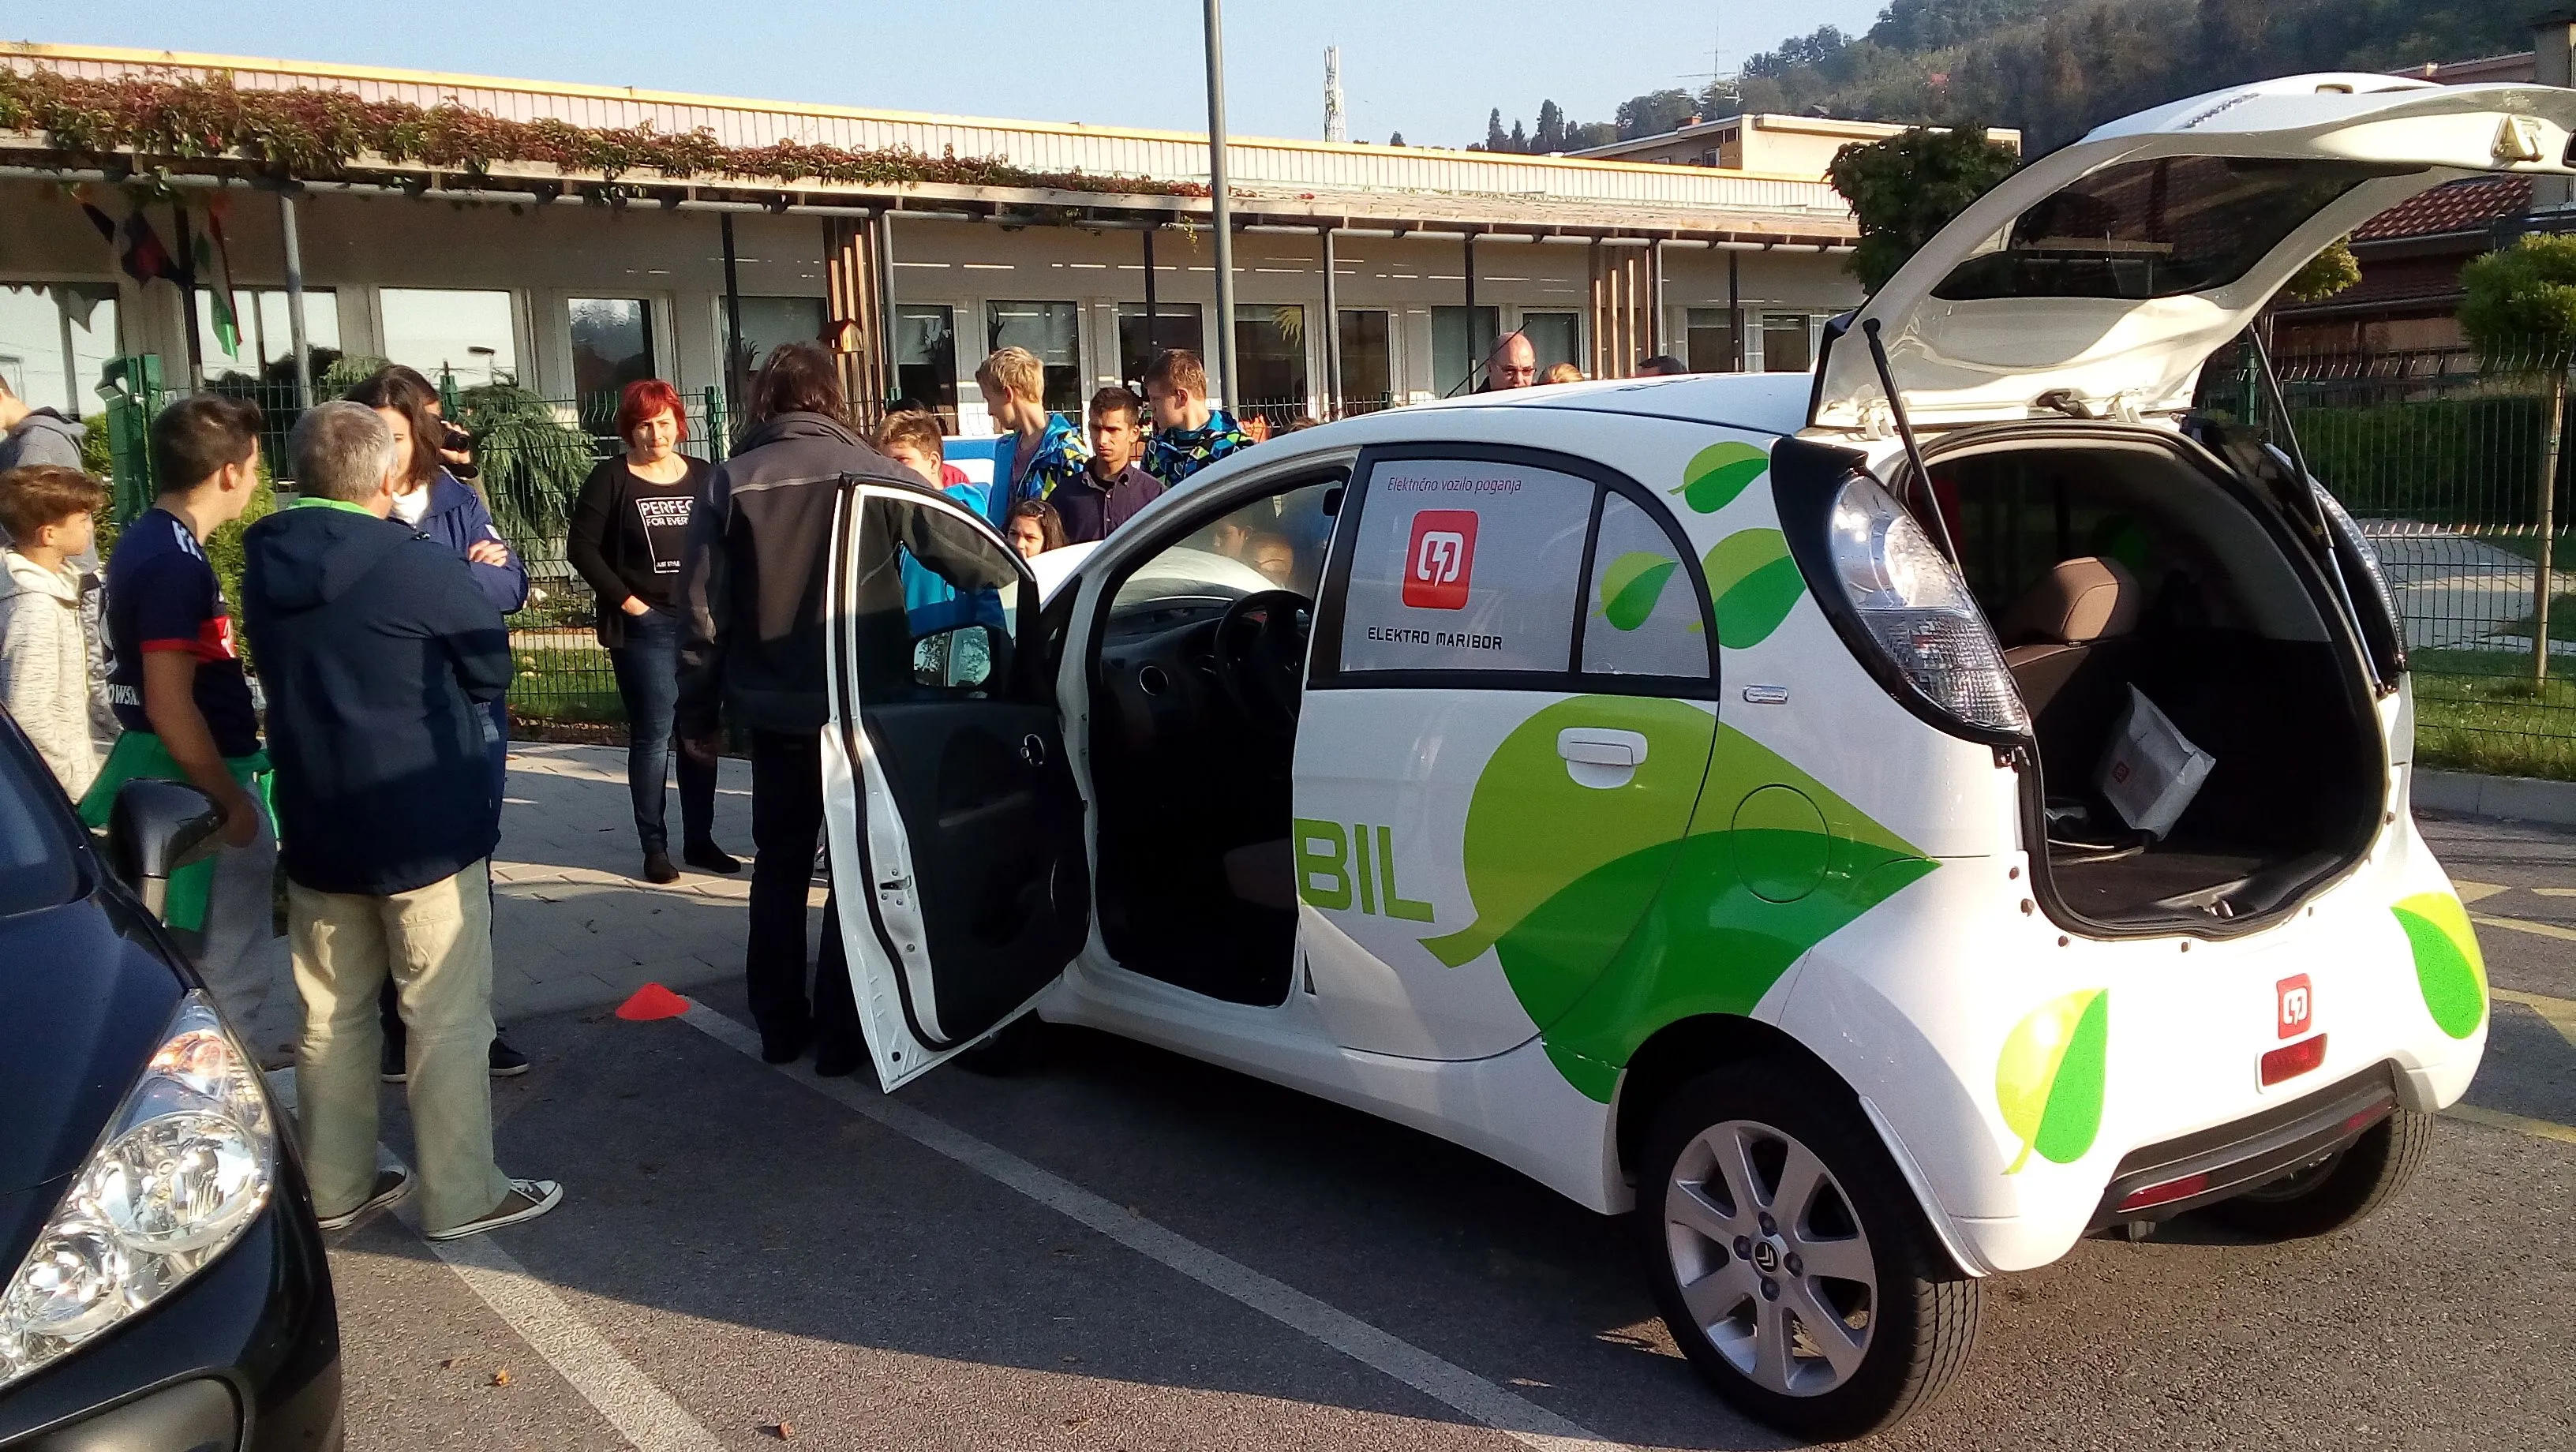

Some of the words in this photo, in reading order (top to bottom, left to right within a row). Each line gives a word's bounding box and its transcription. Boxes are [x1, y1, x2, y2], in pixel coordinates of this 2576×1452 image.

[1441, 476, 1473, 492] vozilo
[1474, 476, 1522, 496] poganja
[646, 517, 665, 527] FOR
[1368, 627, 1430, 645] ELEKTRO
[1436, 632, 1503, 650] MARIBOR
[1294, 817, 1436, 924] BIL
